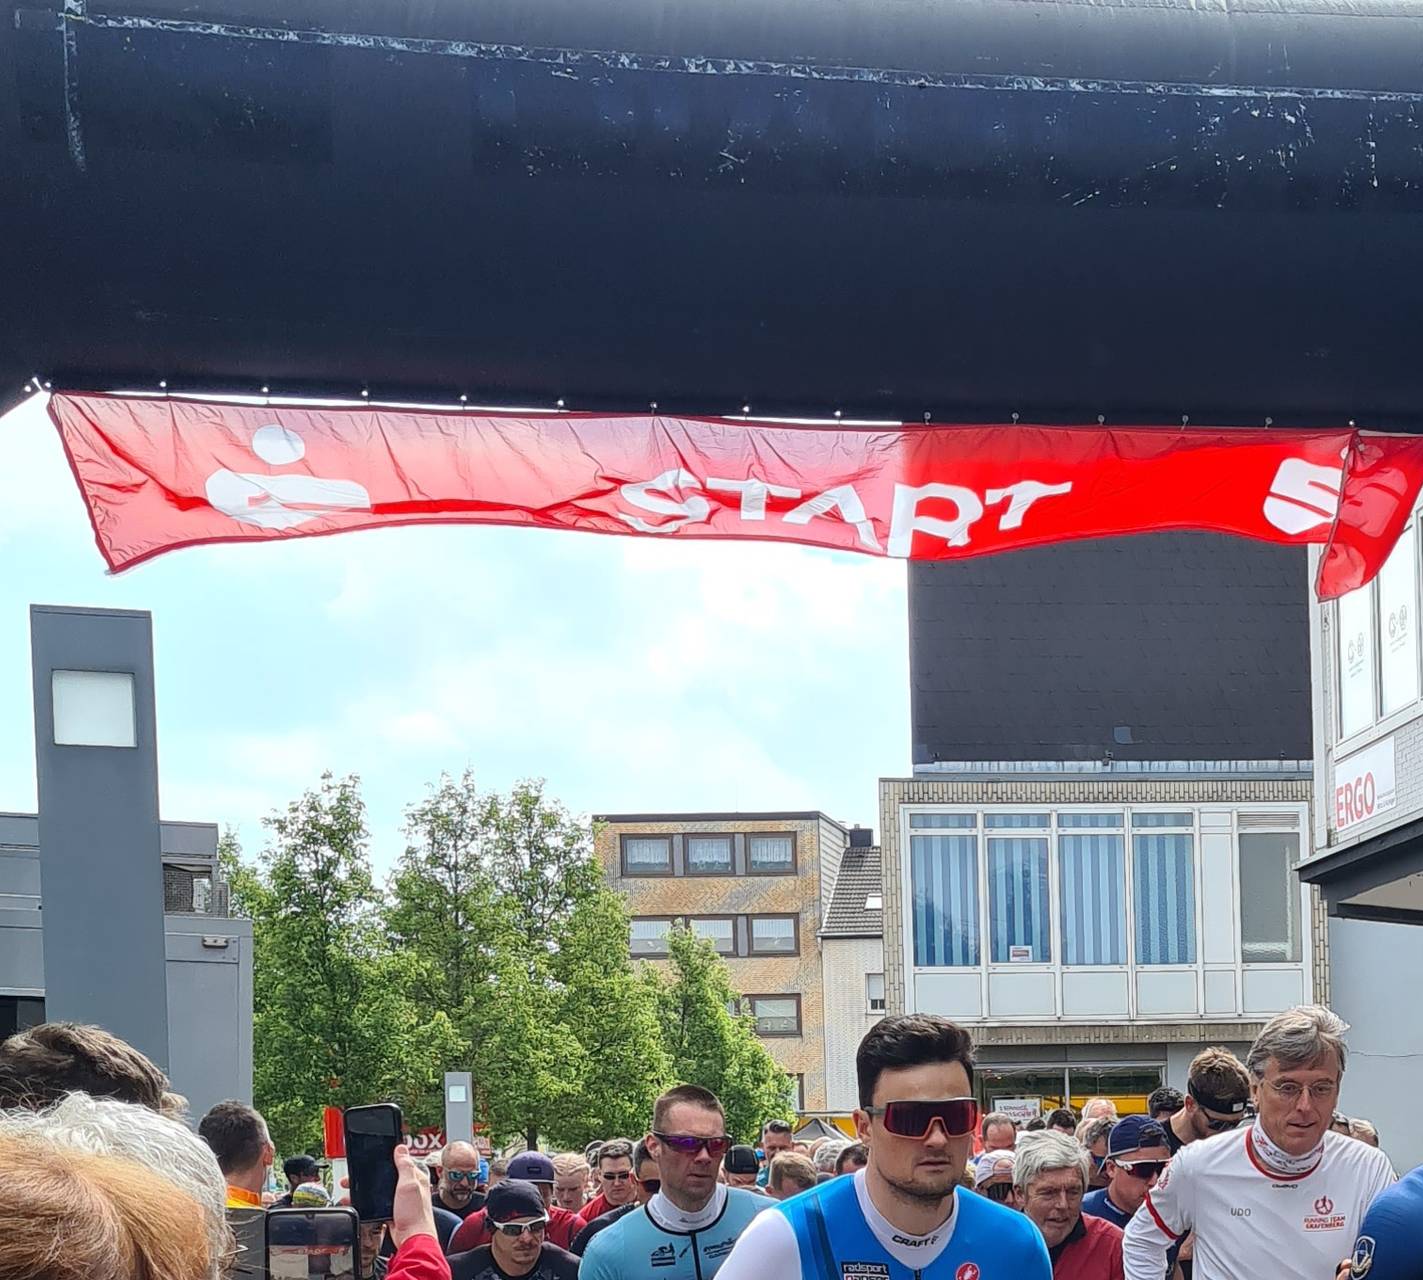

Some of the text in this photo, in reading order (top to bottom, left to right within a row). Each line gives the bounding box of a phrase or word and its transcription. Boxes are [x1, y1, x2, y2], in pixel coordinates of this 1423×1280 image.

[618, 468, 1073, 558] START
[1335, 771, 1376, 828] ERGO
[1230, 1207, 1252, 1217] UDO
[892, 1234, 930, 1248] CRAFT
[843, 1262, 888, 1274] radsport
